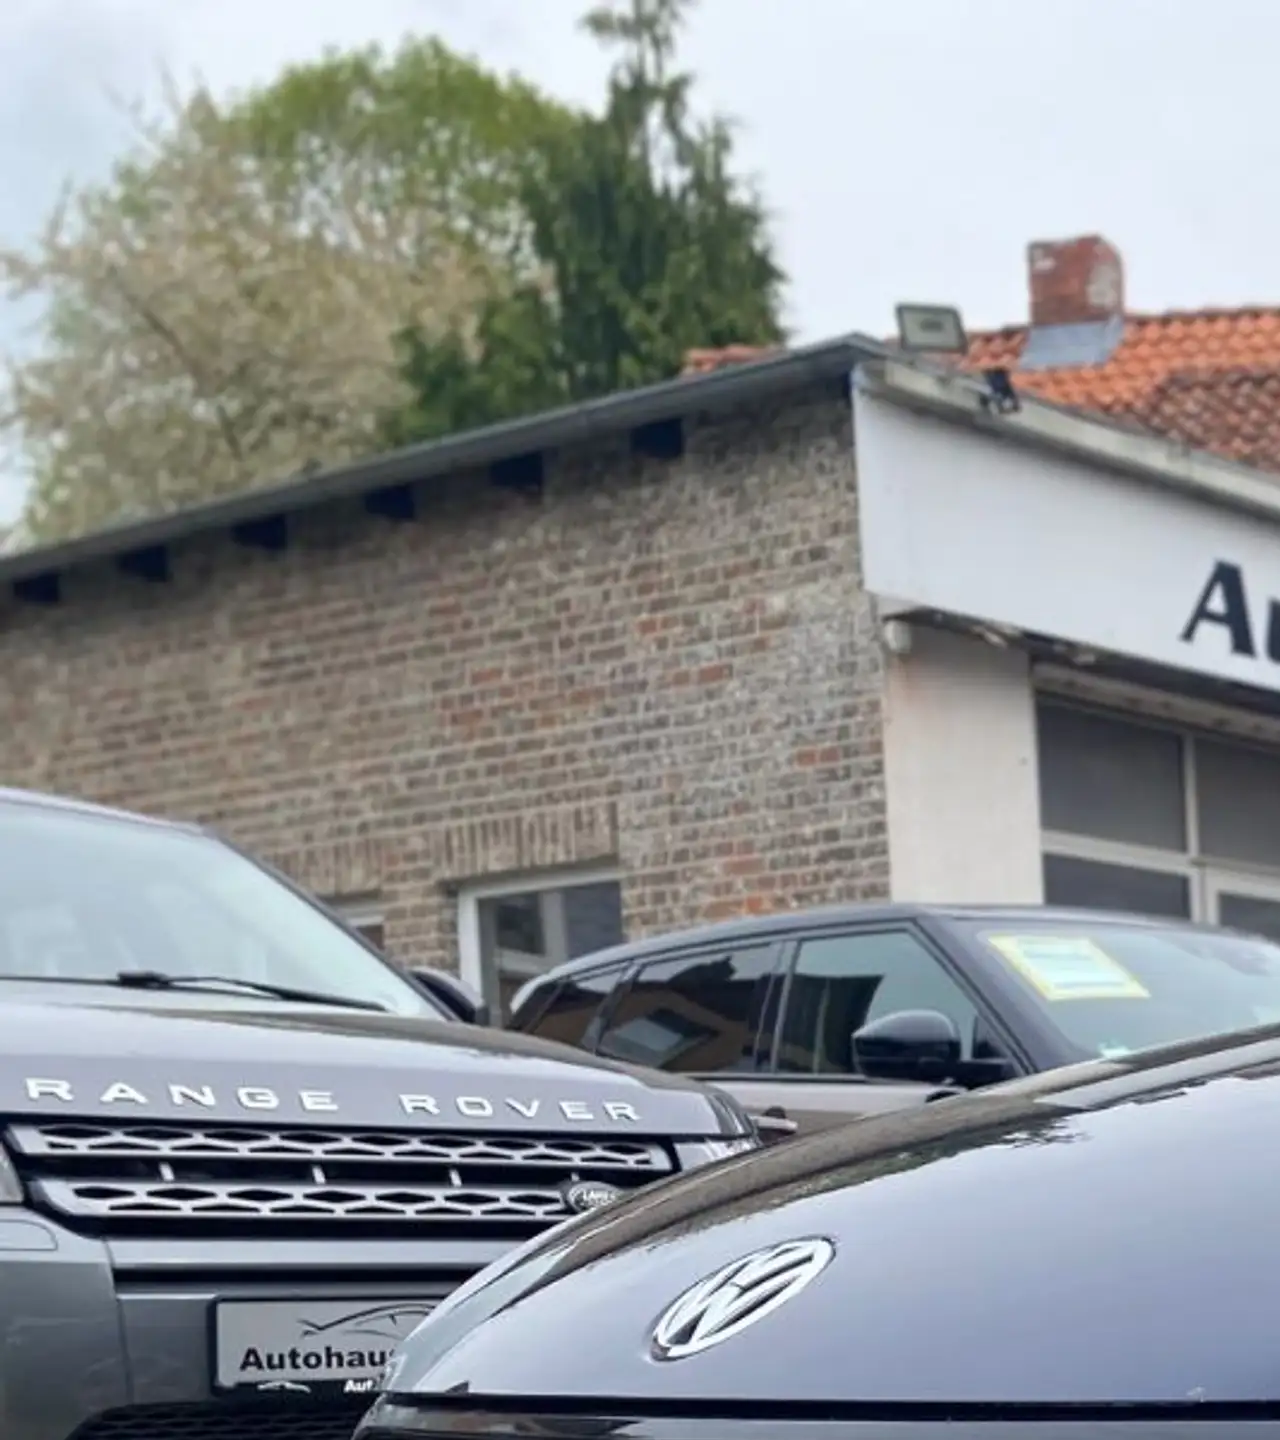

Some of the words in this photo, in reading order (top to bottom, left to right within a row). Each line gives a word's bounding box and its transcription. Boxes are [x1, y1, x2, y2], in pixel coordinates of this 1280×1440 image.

[25, 1077, 338, 1111] RANGE
[399, 1094, 644, 1121] ROVER
[239, 1345, 395, 1371] Autohau
